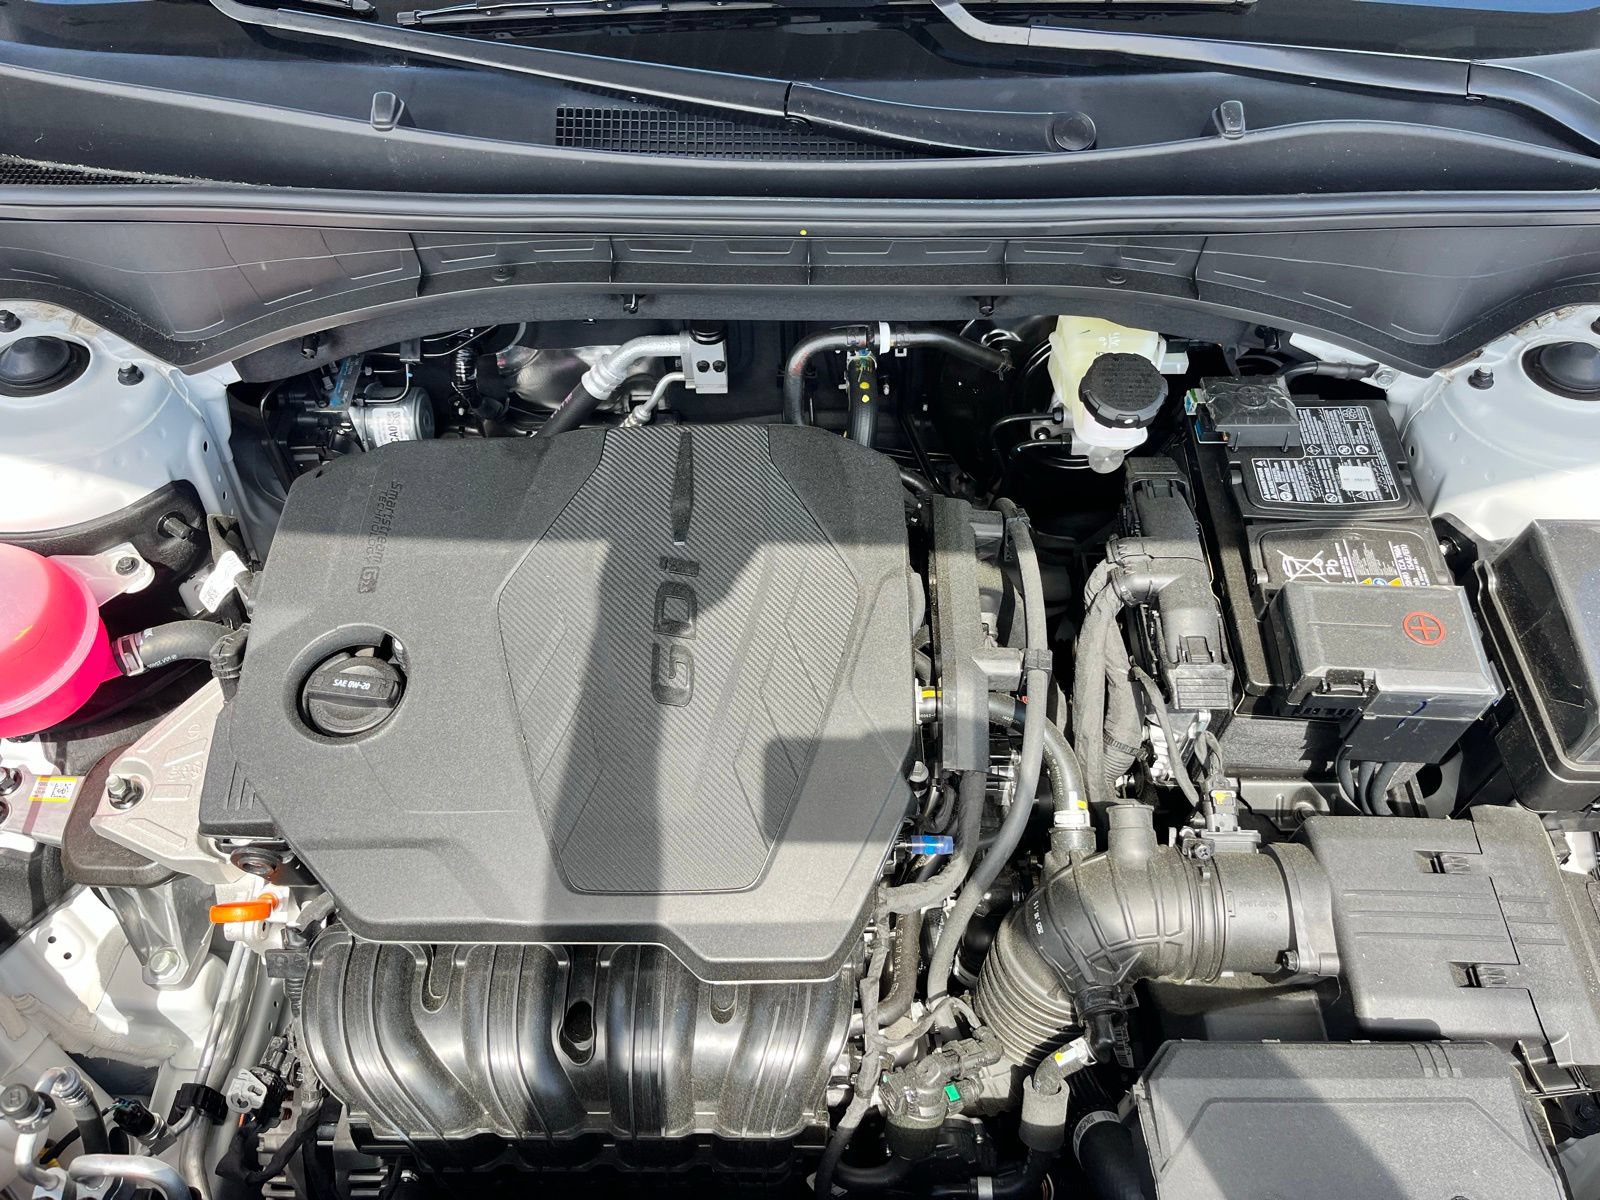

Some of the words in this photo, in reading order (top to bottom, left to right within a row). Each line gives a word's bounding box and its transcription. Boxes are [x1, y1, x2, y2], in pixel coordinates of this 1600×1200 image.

[365, 490, 389, 563] TECHNOLOGY
[374, 481, 404, 563] Smartstream
[1325, 559, 1341, 576] Pb
[650, 556, 699, 707] GDi
[332, 679, 348, 688] SAE
[347, 680, 371, 690] 0W-20
